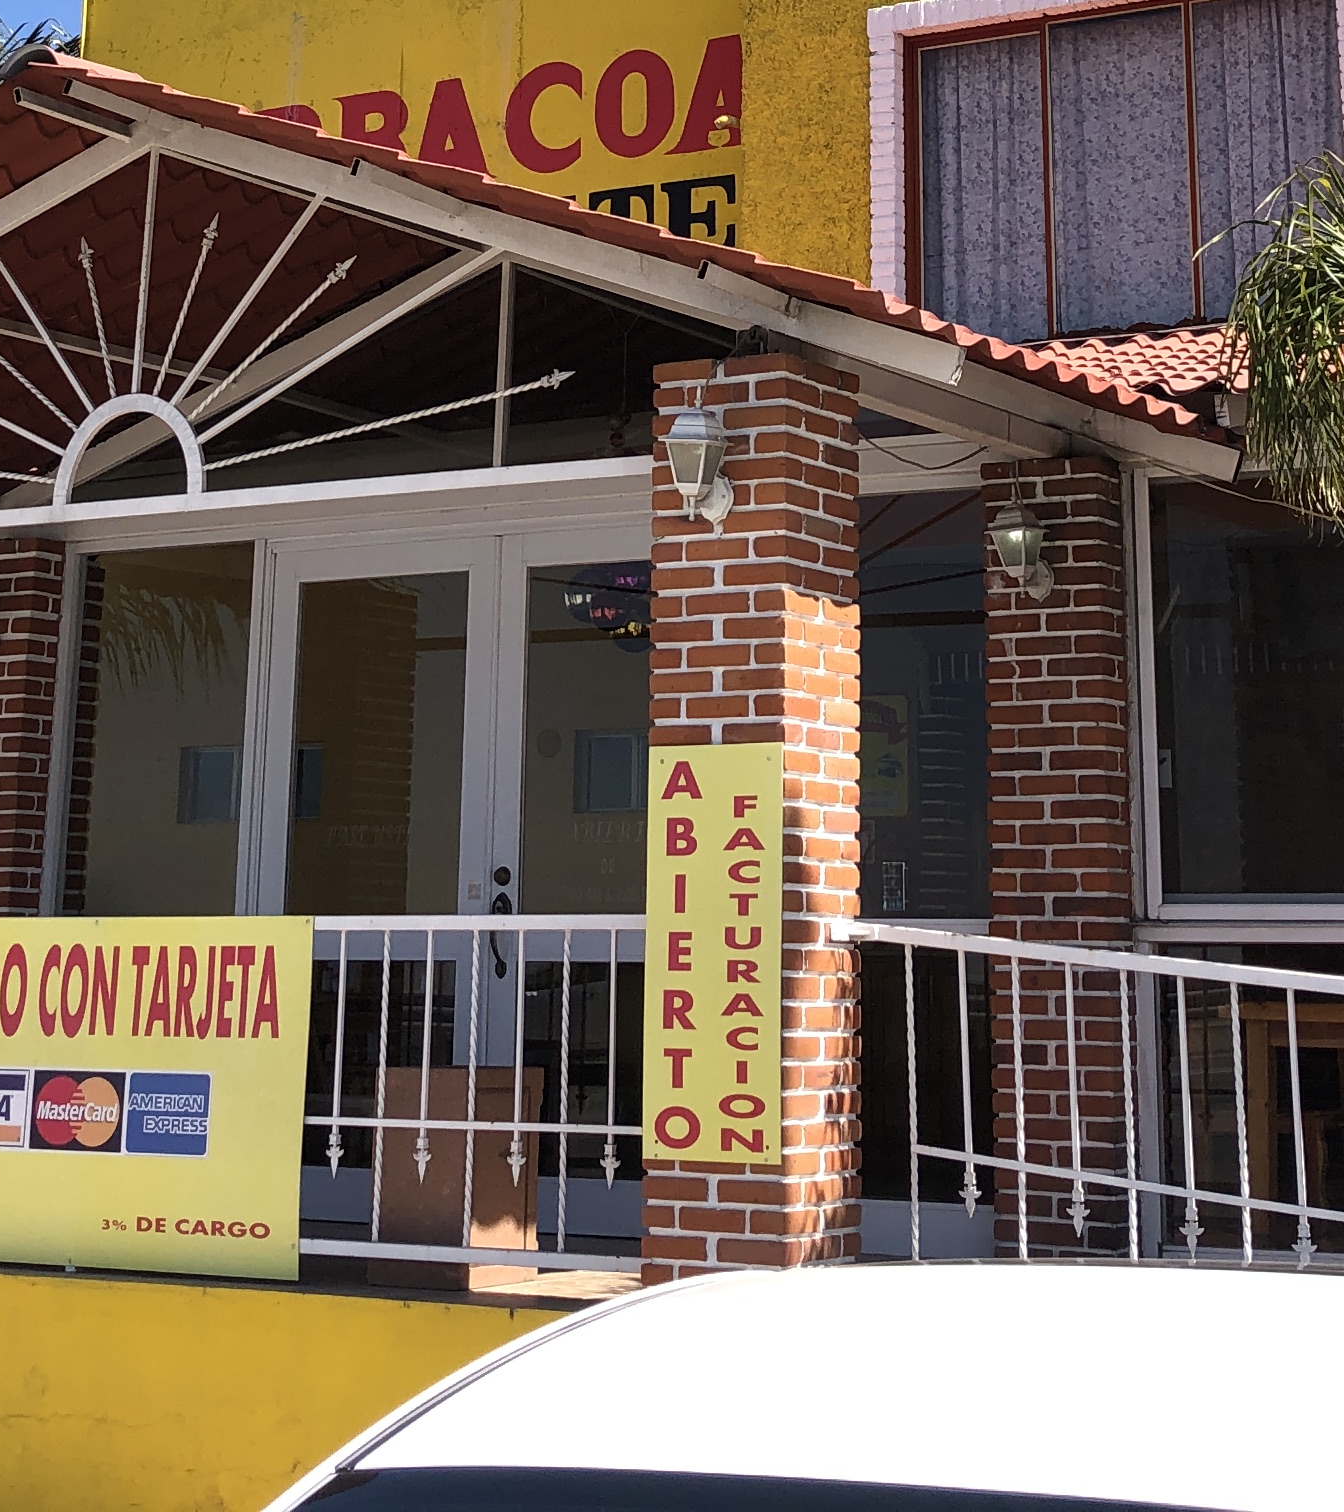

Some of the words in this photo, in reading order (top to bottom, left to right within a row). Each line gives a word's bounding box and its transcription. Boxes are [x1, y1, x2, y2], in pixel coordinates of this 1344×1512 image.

[654, 761, 703, 1151] ABIERTO
[718, 794, 767, 1154] FACTURACION
[39, 942, 121, 1039] CON
[129, 944, 280, 1040] TARJETA
[37, 1100, 120, 1123] MasterCard
[128, 1093, 205, 1113] AMERICAN
[143, 1116, 207, 1135] EXPRESS
[101, 1218, 127, 1232] 3%
[136, 1216, 167, 1234] DE
[174, 1218, 271, 1239] CARGO
